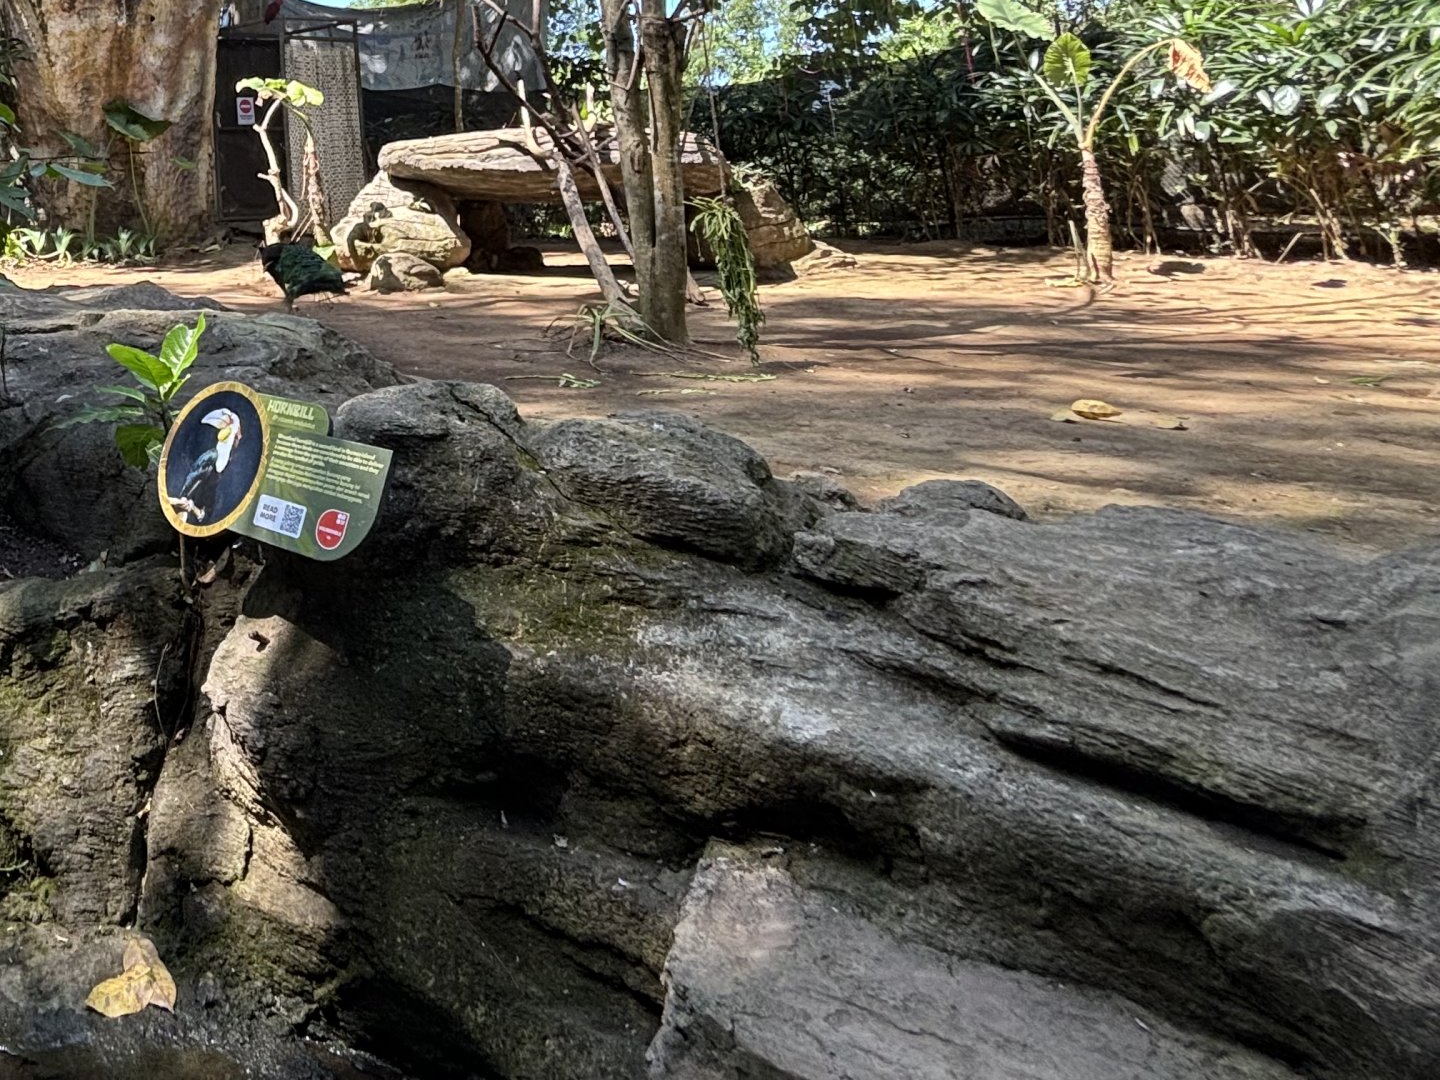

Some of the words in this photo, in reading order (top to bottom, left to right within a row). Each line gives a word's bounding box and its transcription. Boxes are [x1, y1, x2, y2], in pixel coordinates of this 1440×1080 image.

[267, 399, 314, 420] HORNBILL
[262, 503, 279, 514] READ
[260, 512, 277, 522] MORE
